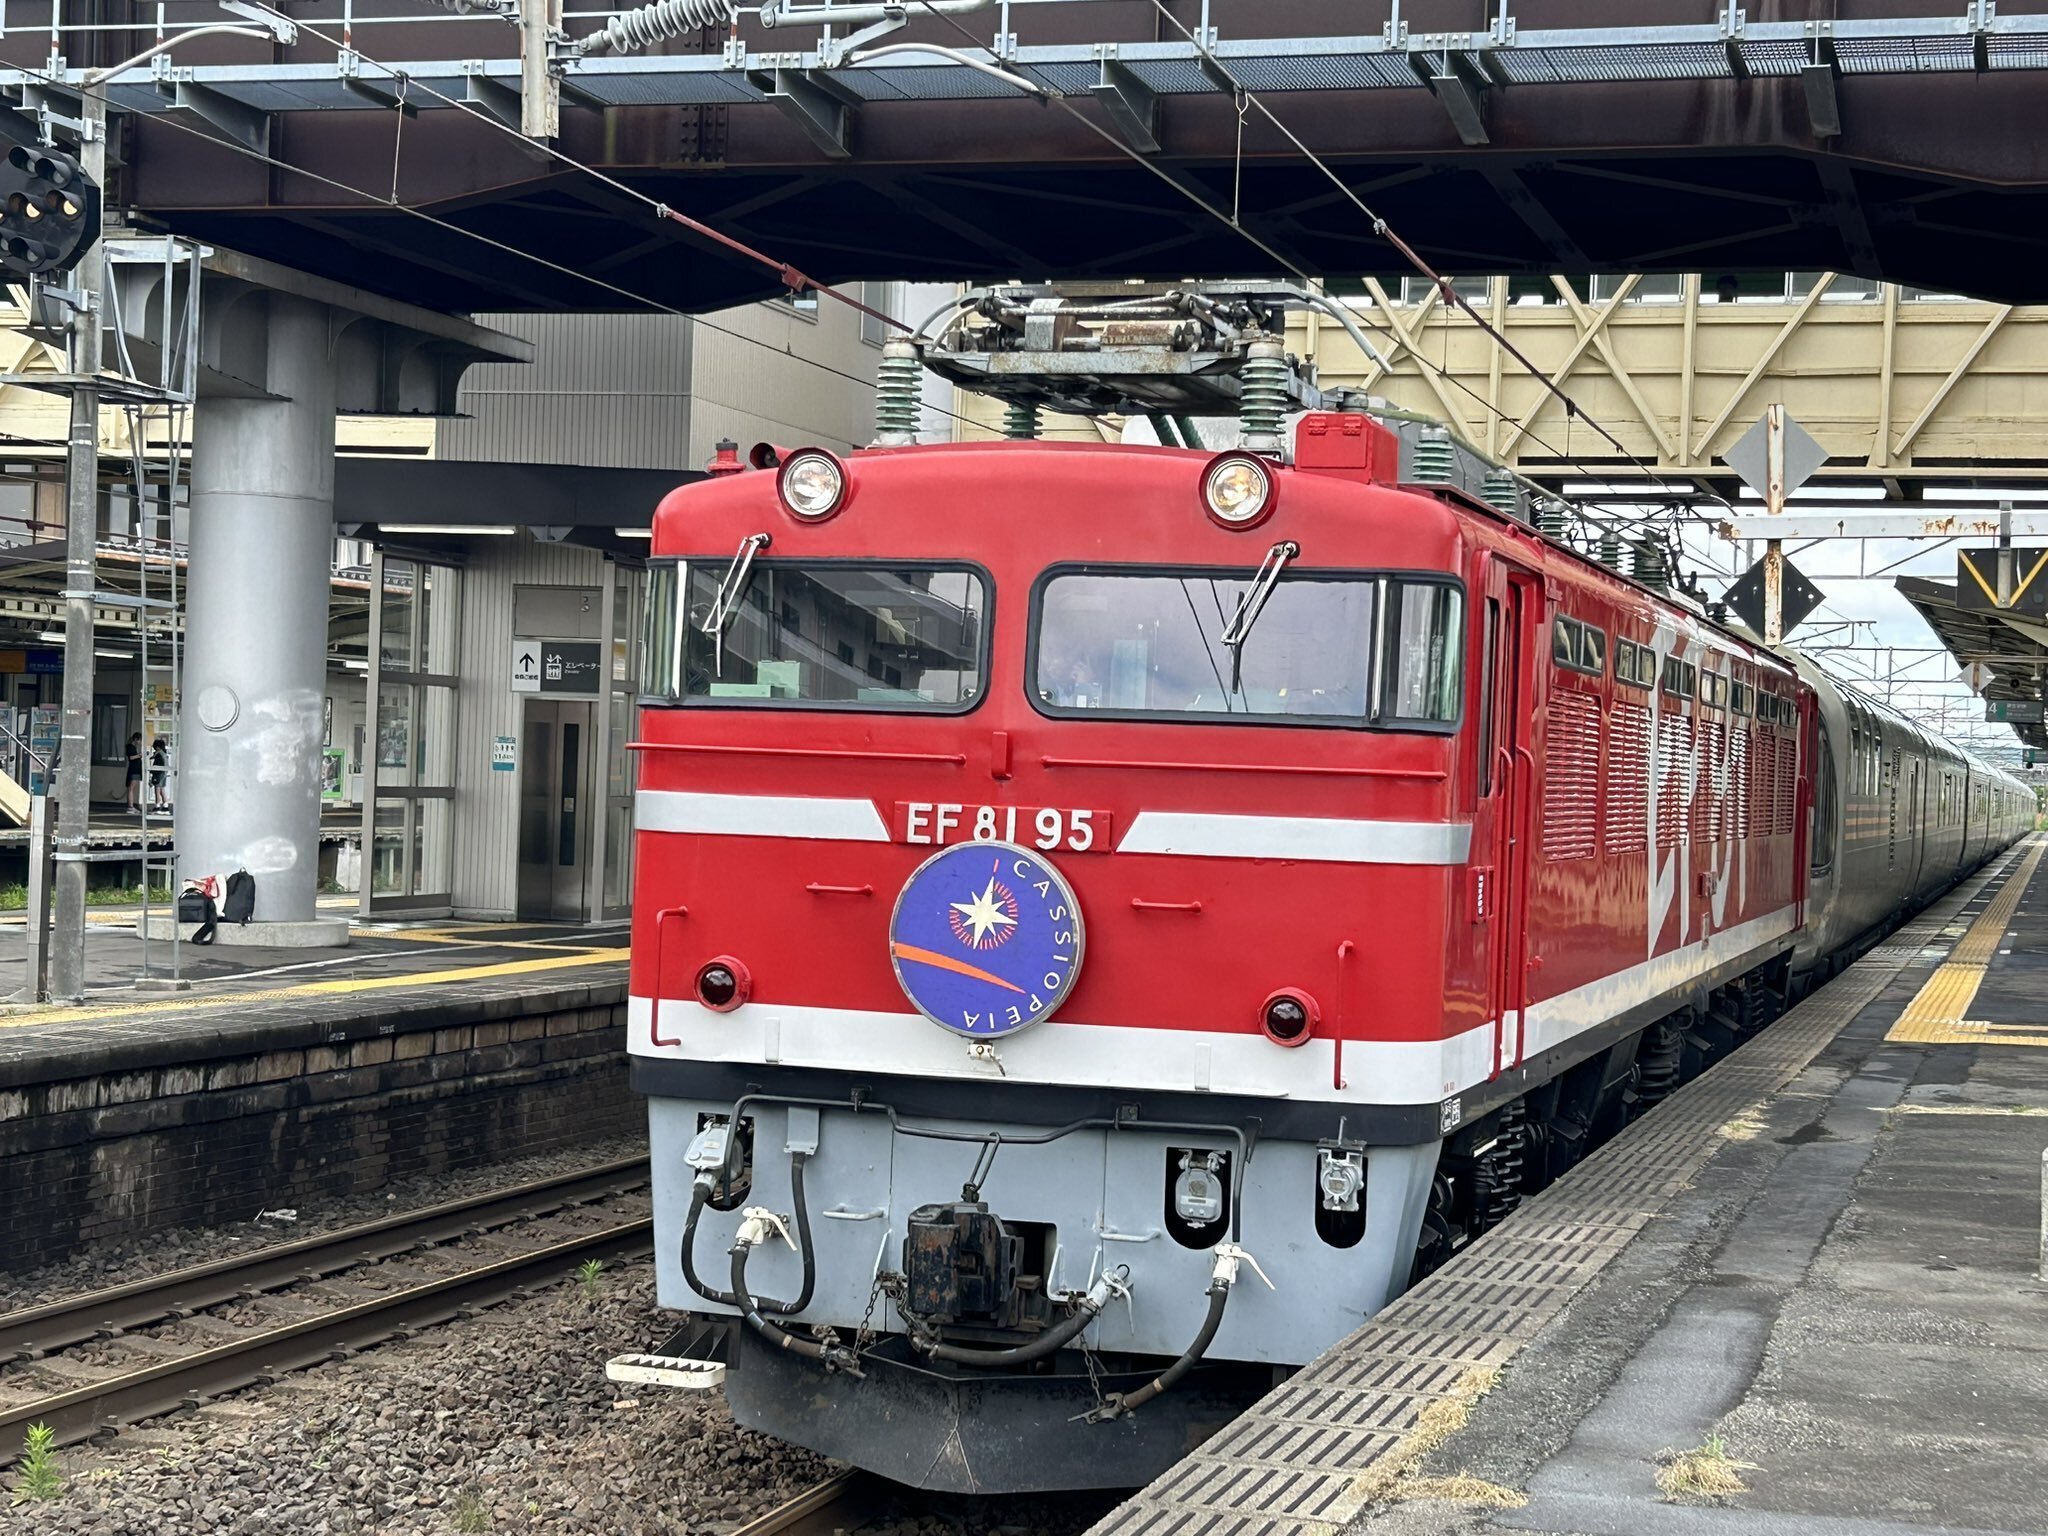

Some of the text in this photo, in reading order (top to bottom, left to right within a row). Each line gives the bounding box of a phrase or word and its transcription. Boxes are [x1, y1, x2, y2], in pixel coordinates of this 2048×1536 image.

[1989, 702, 1998, 713] 4
[1035, 808, 1093, 851] 95
[963, 860, 1071, 1029] CASSIOPEIA
